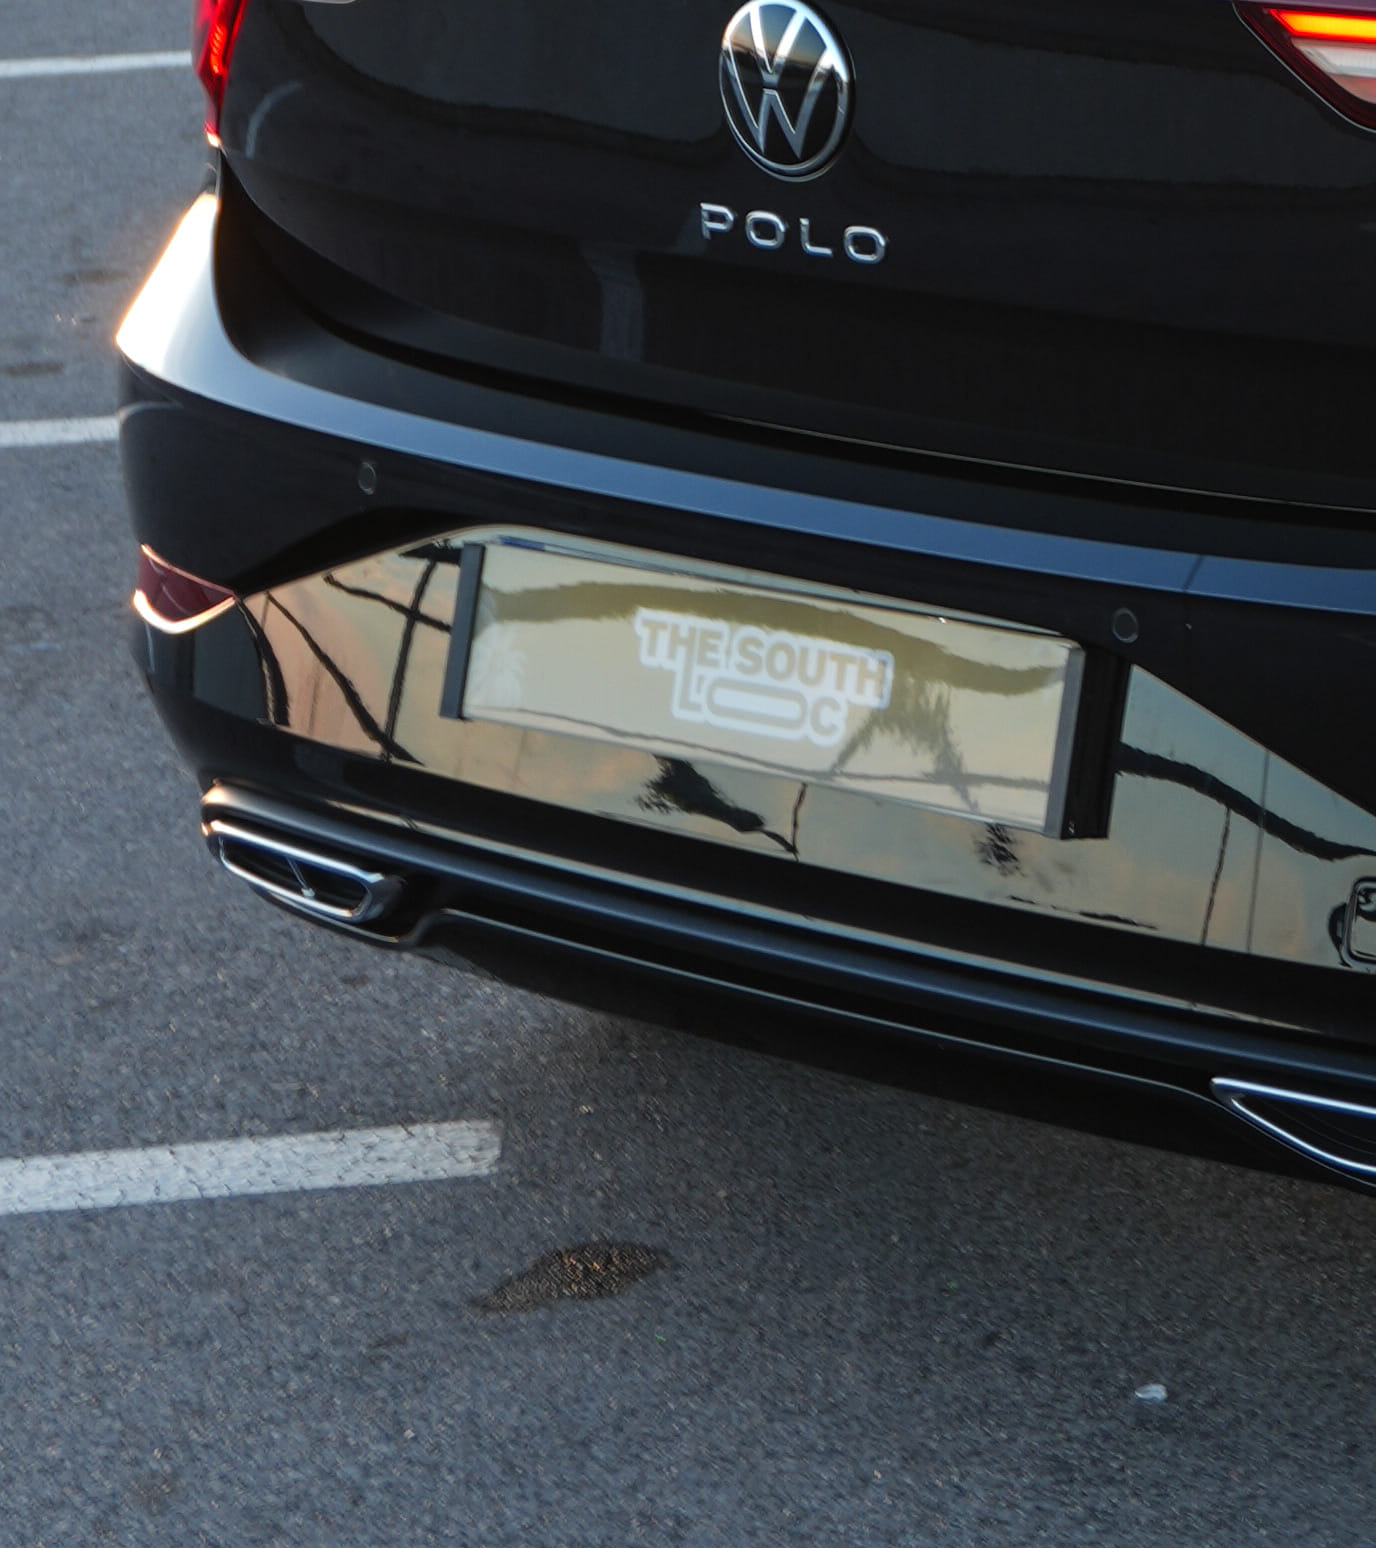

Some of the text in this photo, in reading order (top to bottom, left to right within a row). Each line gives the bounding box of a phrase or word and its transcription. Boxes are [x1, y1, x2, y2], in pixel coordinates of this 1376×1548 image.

[701, 202, 887, 265] POLO
[640, 617, 888, 701] THE SOUTH
